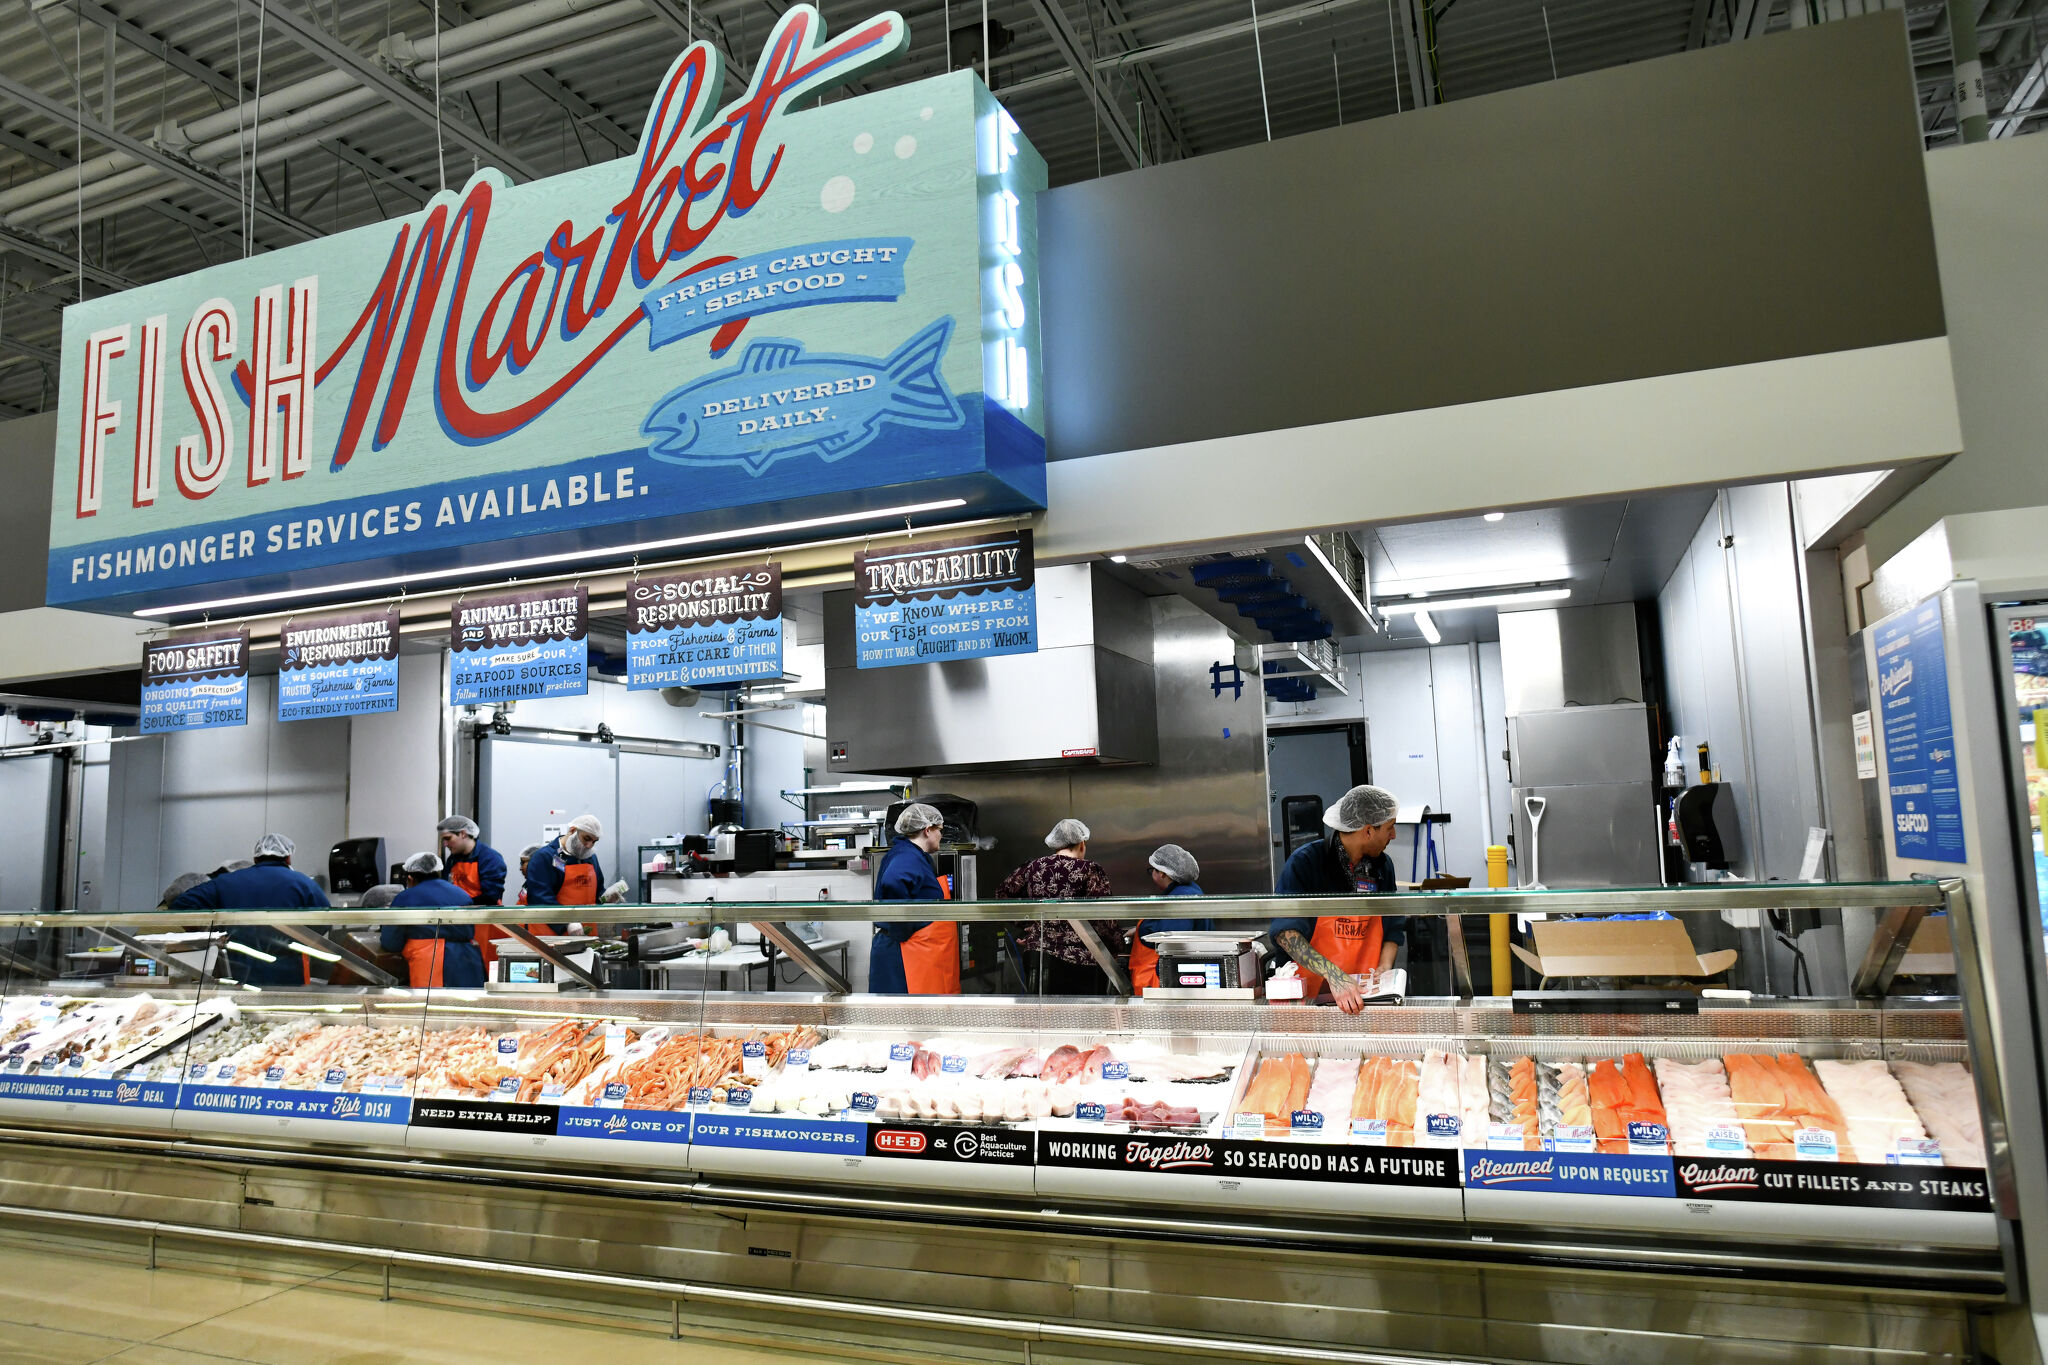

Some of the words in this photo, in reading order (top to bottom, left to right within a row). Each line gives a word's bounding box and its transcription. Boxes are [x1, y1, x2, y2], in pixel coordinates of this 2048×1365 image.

[76, 275, 318, 518] FISH
[231, 12, 893, 473] Market
[998, 109, 1028, 410] FISH
[657, 265, 758, 311] FRESH
[768, 247, 897, 276] CAUGHT
[705, 272, 845, 315] SEAFOOD
[703, 374, 876, 418] DELIVERED
[738, 406, 836, 436] DAILY.
[72, 530, 255, 583] FISHMONGER
[266, 502, 422, 553] SERVICES
[435, 467, 649, 525] AVAILABLE.
[866, 548, 1020, 594] TRACEABILITY
[663, 575, 744, 600] SOCIAL
[459, 604, 518, 625] ANIMAL
[520, 596, 578, 618] HEALTH
[637, 593, 771, 626] RESPONSIBILITY
[873, 612, 899, 624] WE
[902, 605, 945, 623] KNOW
[948, 599, 1014, 616] WHERE
[286, 621, 390, 646] ENVIRONMENTAL
[462, 630, 484, 638] AND
[488, 616, 577, 639] WELFARE
[632, 639, 668, 650] FROM
[670, 631, 724, 651] Fisheries
[727, 628, 735, 643] &
[738, 624, 777, 644] Farms
[861, 631, 890, 642] OUR
[890, 625, 927, 642] FISH
[930, 622, 980, 635] COMES
[985, 616, 1029, 629] FROM
[148, 651, 183, 673] FOOD
[187, 643, 242, 669] SAFETY
[301, 637, 392, 664] RESPONSIBILITY
[471, 657, 487, 666] WE
[495, 655, 514, 663] MAKE
[517, 652, 535, 661] SURE
[544, 649, 566, 659] OUR
[632, 655, 656, 667] THAT
[658, 651, 693, 664] TAKE
[697, 648, 730, 661] CARE
[733, 646, 746, 658] OF
[749, 642, 776, 655] THEIR
[863, 650, 883, 661] HOW
[885, 649, 894, 659] IT
[896, 647, 915, 658] WAS
[917, 639, 956, 657] CAUGHT
[958, 640, 977, 651] AND
[980, 638, 992, 648] BY
[993, 632, 1031, 647] WHOM.
[292, 674, 306, 682] WE
[310, 669, 348, 680] SOURCE
[353, 666, 382, 675] FROM
[456, 670, 514, 685] SEAFOOD
[521, 663, 581, 679] SOURCES
[634, 670, 678, 684] PEOPLE
[681, 667, 689, 682] &
[692, 661, 778, 679] COMMUNITIES.
[145, 688, 189, 701] ONGOING
[282, 684, 310, 696] TRUSTED
[312, 680, 354, 698] Fisheries
[355, 678, 362, 690] &
[364, 674, 395, 692] Farms
[454, 689, 477, 702] follow
[480, 682, 544, 698] FISH-FRIENDLY
[145, 704, 163, 714] FOR
[166, 700, 209, 714] QUALITY
[144, 714, 186, 729] SOURCE
[744, 1044, 762, 1052] WILD
[1105, 1065, 1125, 1073] WILD
[11, 1083, 64, 1096] FISHMONGERS
[117, 1083, 141, 1101] Reel
[143, 1091, 164, 1102] DEAL
[691, 1090, 709, 1098] WILD
[855, 1096, 874, 1105] WILD
[194, 1093, 236, 1108] COOKING
[240, 1095, 262, 1109] TIPS
[266, 1101, 293, 1111] FOR
[297, 1103, 328, 1112] ANY
[332, 1096, 361, 1116] Fish
[365, 1102, 391, 1117] DISH
[420, 1109, 455, 1118] NEED
[458, 1111, 504, 1121] EXTRA
[507, 1114, 551, 1124] HELP?
[1080, 1107, 1100, 1115] WILD
[565, 1117, 601, 1127] JUST
[603, 1115, 628, 1132] Ask
[631, 1121, 661, 1131] ONE
[666, 1123, 685, 1133] OF
[1295, 1114, 1319, 1123] WILD
[1431, 1119, 1456, 1127] WILD
[697, 1124, 731, 1136] OUR
[735, 1127, 859, 1143] FISHMONGERS.
[1632, 1126, 1661, 1136] WILD
[1799, 1135, 1831, 1143] RAISED
[934, 1139, 947, 1148] &
[980, 1142, 1026, 1151] Aquaculture
[980, 1150, 1014, 1158] Practices
[1049, 1141, 1117, 1160] WORKING
[1126, 1141, 1214, 1170] Together
[1224, 1150, 1244, 1166] SO
[1249, 1152, 1322, 1171] SEAFOOD
[1327, 1155, 1359, 1173] HAS
[1364, 1157, 1375, 1173] A
[1380, 1158, 1446, 1177] FUTURE
[1470, 1157, 1554, 1185] Steamed
[1558, 1165, 1600, 1181] UPON
[1603, 1167, 1669, 1184] REQUEST
[1679, 1163, 1760, 1191] Custom
[1763, 1172, 1795, 1189] CUT
[1798, 1174, 1860, 1192] FILLETS
[1865, 1180, 1914, 1193] AND
[1920, 1180, 1985, 1197] STEAKS
